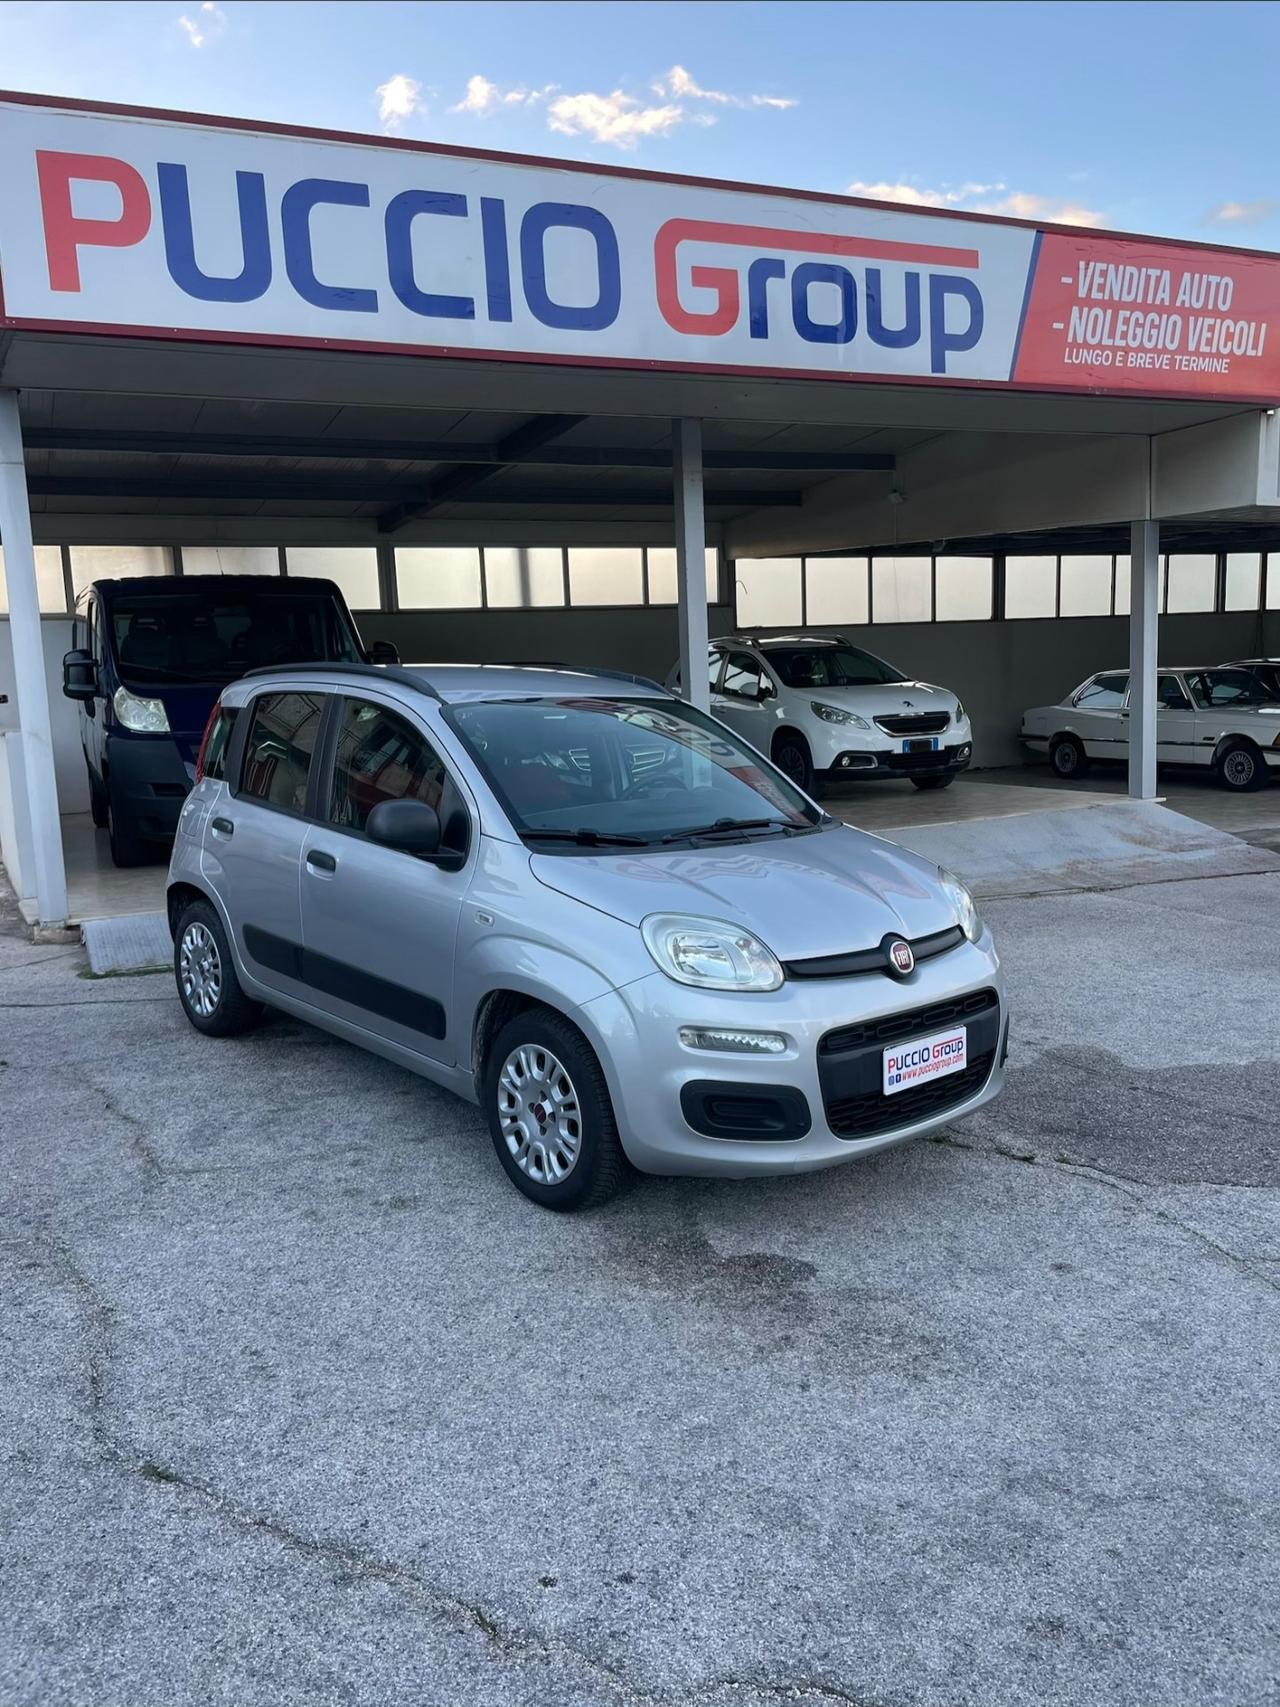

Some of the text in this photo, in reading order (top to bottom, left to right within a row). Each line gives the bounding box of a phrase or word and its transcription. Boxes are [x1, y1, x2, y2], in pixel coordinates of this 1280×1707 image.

[36, 149, 622, 332] PUCCIO
[1176, 272, 1234, 312] AUTO
[1187, 316, 1267, 356] VEICOLI
[1064, 348, 1230, 374] LUNGO E BREVE TERMINE
[888, 1047, 930, 1074] PUCCIO
[903, 1054, 963, 1081] www.pucciogroup.com
